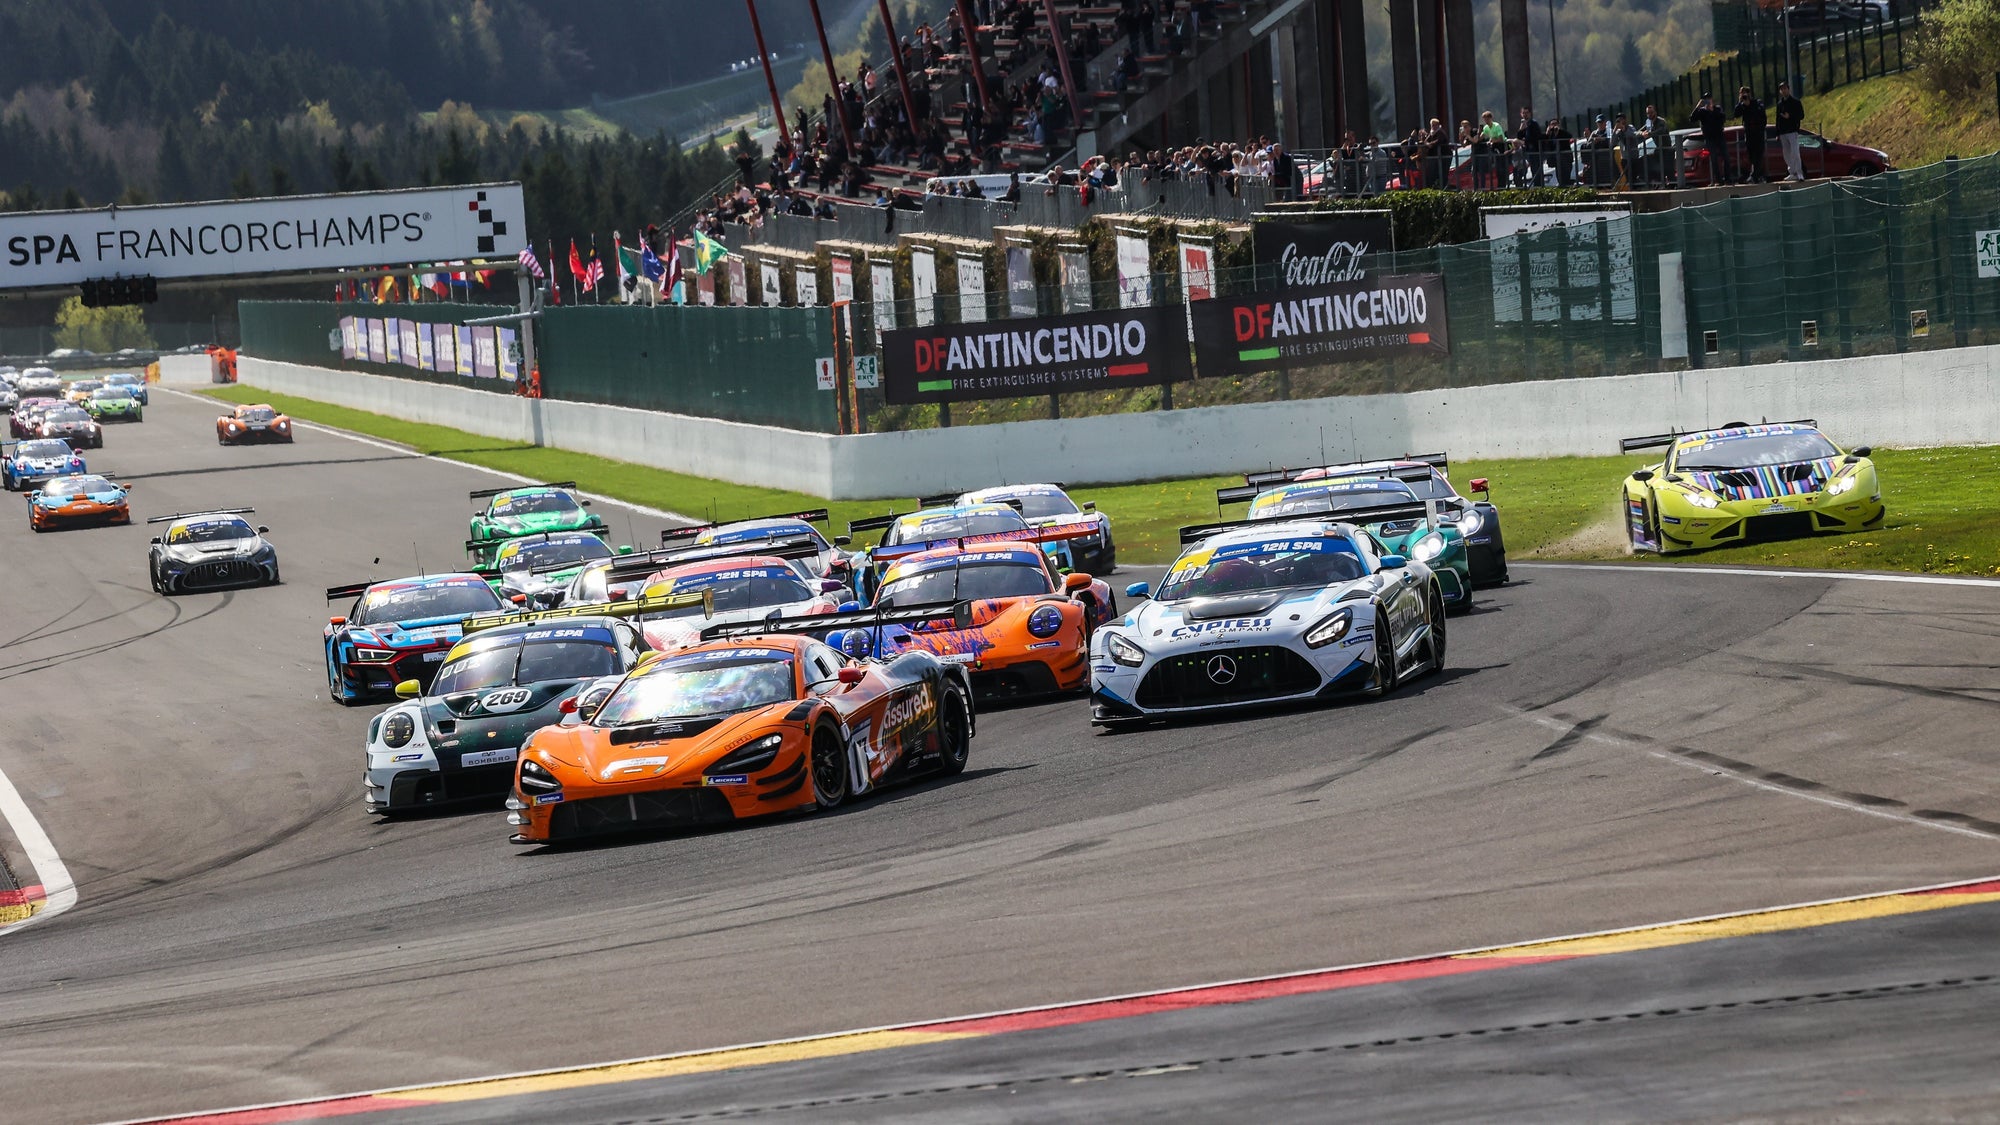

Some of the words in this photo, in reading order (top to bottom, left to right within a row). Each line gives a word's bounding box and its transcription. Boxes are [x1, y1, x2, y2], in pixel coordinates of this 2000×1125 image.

[8, 234, 81, 266] SPA
[1233, 286, 1427, 342] DFANTINCENDIO
[915, 319, 1146, 373] DFANTINCENDIO
[1279, 345, 1301, 357] FIRE
[1306, 337, 1375, 354] EXTINGUISHER
[1379, 334, 1409, 346] SYSTEMS
[952, 378, 975, 389] FIRE
[979, 370, 1057, 388] EXTINGUISHER
[1061, 366, 1109, 381] SYSTEMS
[1261, 542, 1290, 551] 12H
[1291, 541, 1322, 551] SPA
[957, 553, 982, 562] 12H
[985, 552, 1013, 560] SPA
[715, 571, 740, 580] 12H
[742, 570, 767, 578] SPA
[525, 630, 552, 640] 12H
[554, 629, 584, 638] SPA
[1169, 633, 1200, 643] LAND
[1210, 626, 1271, 635] COMPANY
[737, 649, 771, 657] SPA
[486, 691, 528, 707] 269
